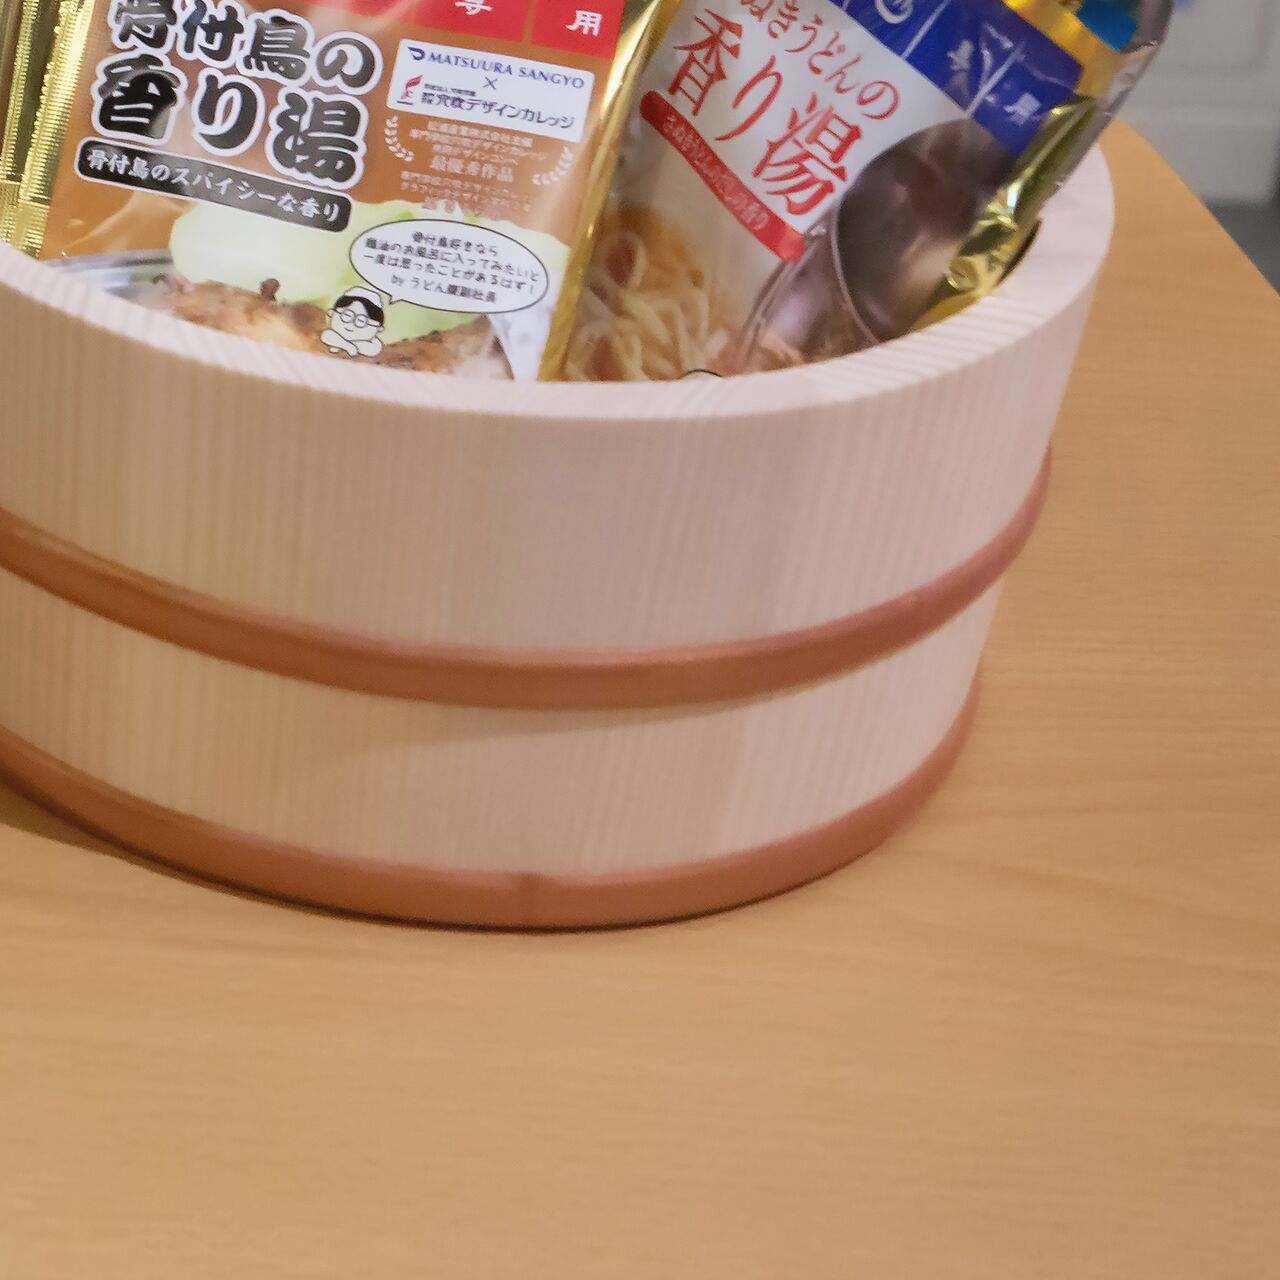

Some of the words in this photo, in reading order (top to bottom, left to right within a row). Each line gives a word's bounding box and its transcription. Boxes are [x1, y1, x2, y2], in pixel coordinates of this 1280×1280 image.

[93, 53, 367, 188] 香り湯
[429, 52, 512, 76] MATSUURA
[518, 67, 584, 89] SANGYO
[667, 8, 864, 216] 香り湯
[86, 148, 340, 221] 骨付鳥のスパイシーな香り
